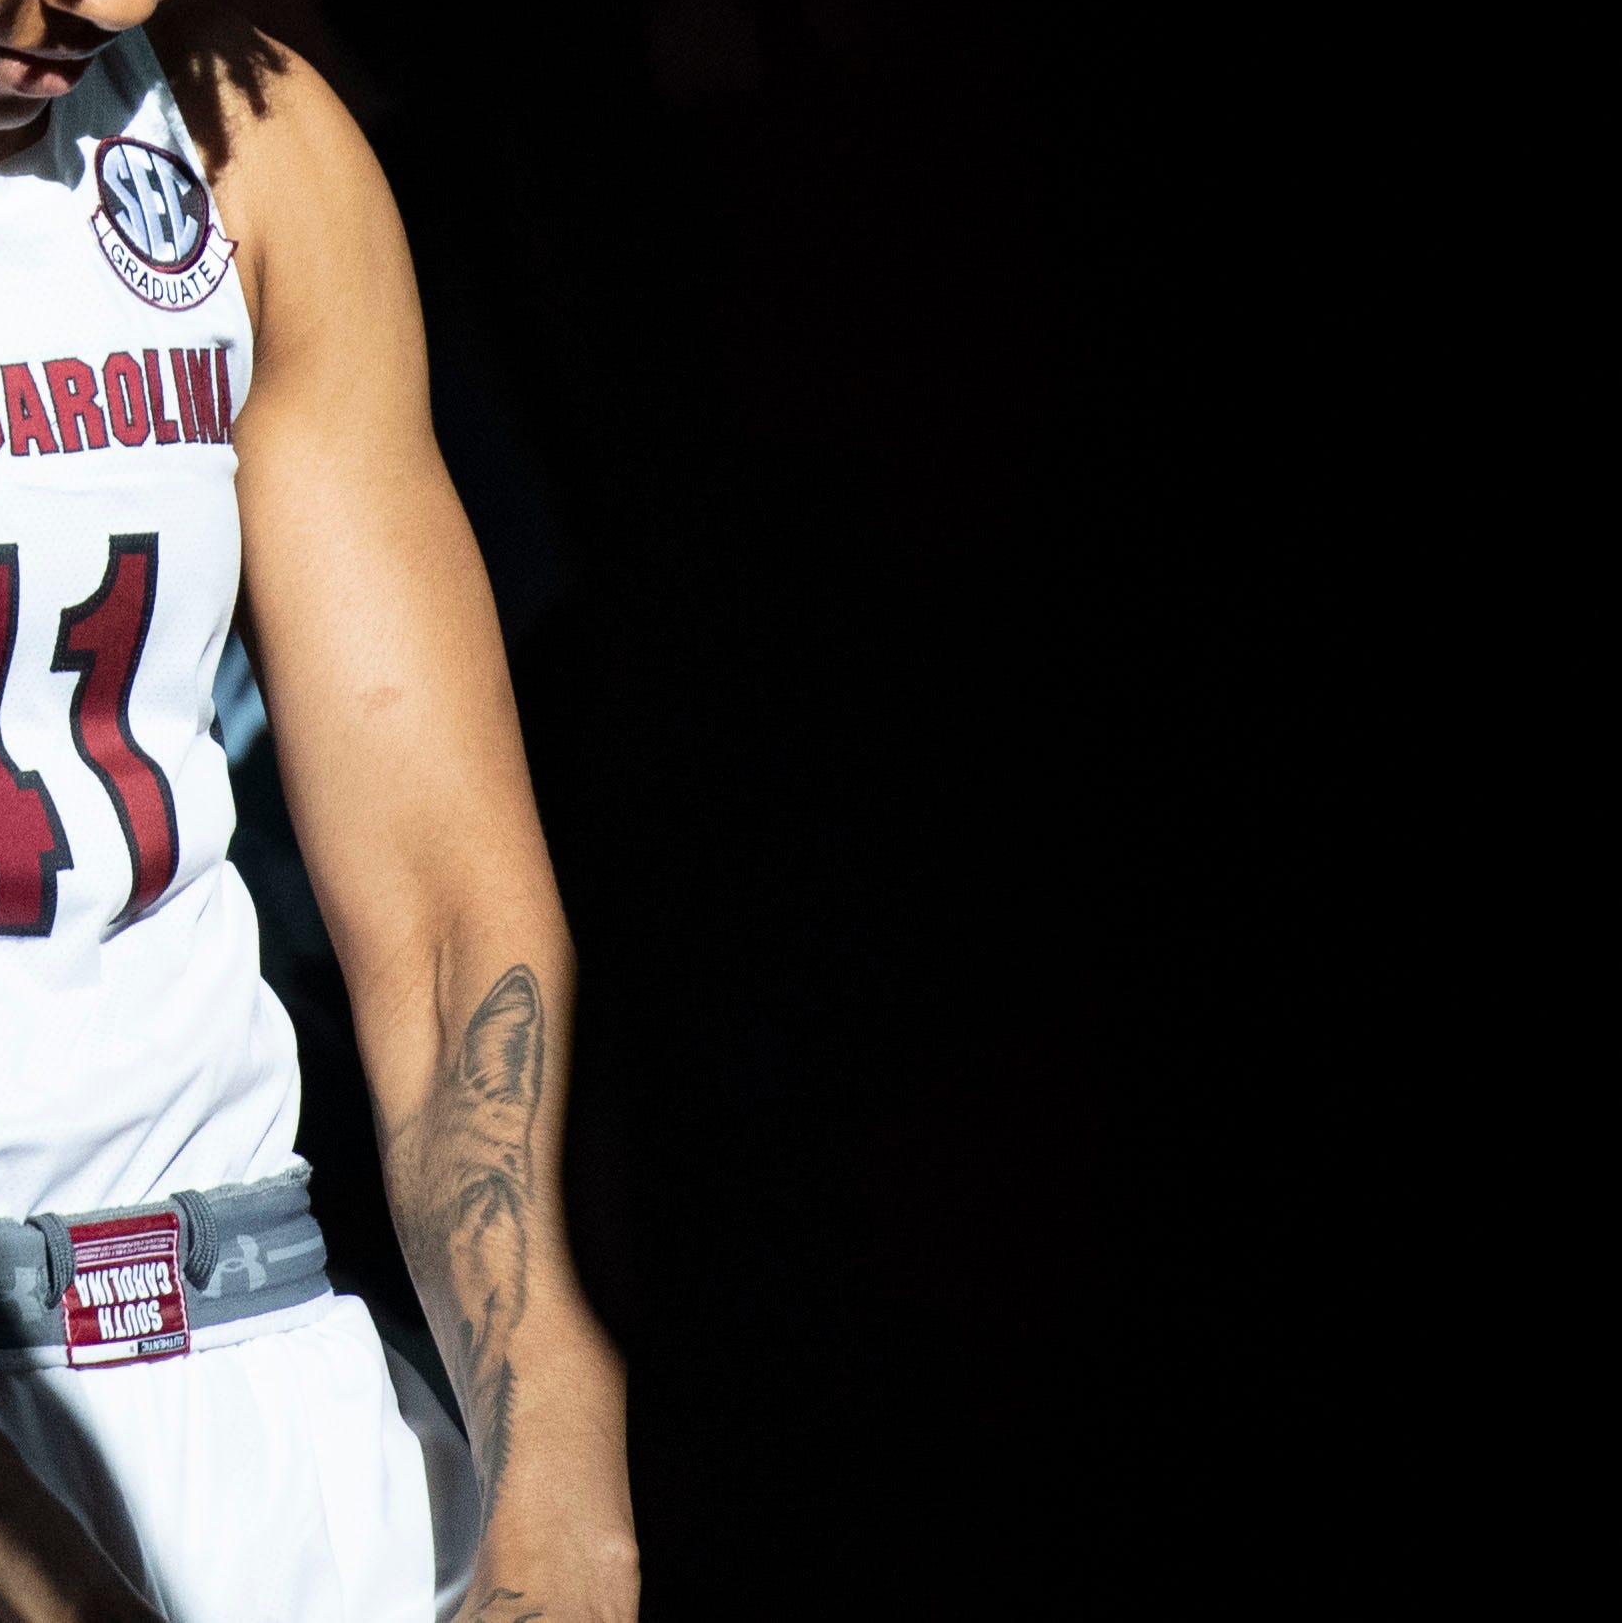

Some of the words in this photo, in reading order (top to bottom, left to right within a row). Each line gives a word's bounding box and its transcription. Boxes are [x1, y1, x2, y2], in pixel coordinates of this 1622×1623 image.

[102, 143, 200, 263] SEC
[110, 243, 217, 306] GRADUATE
[75, 1262, 173, 1307] CAROLINA
[97, 1299, 164, 1340] SOUTH
